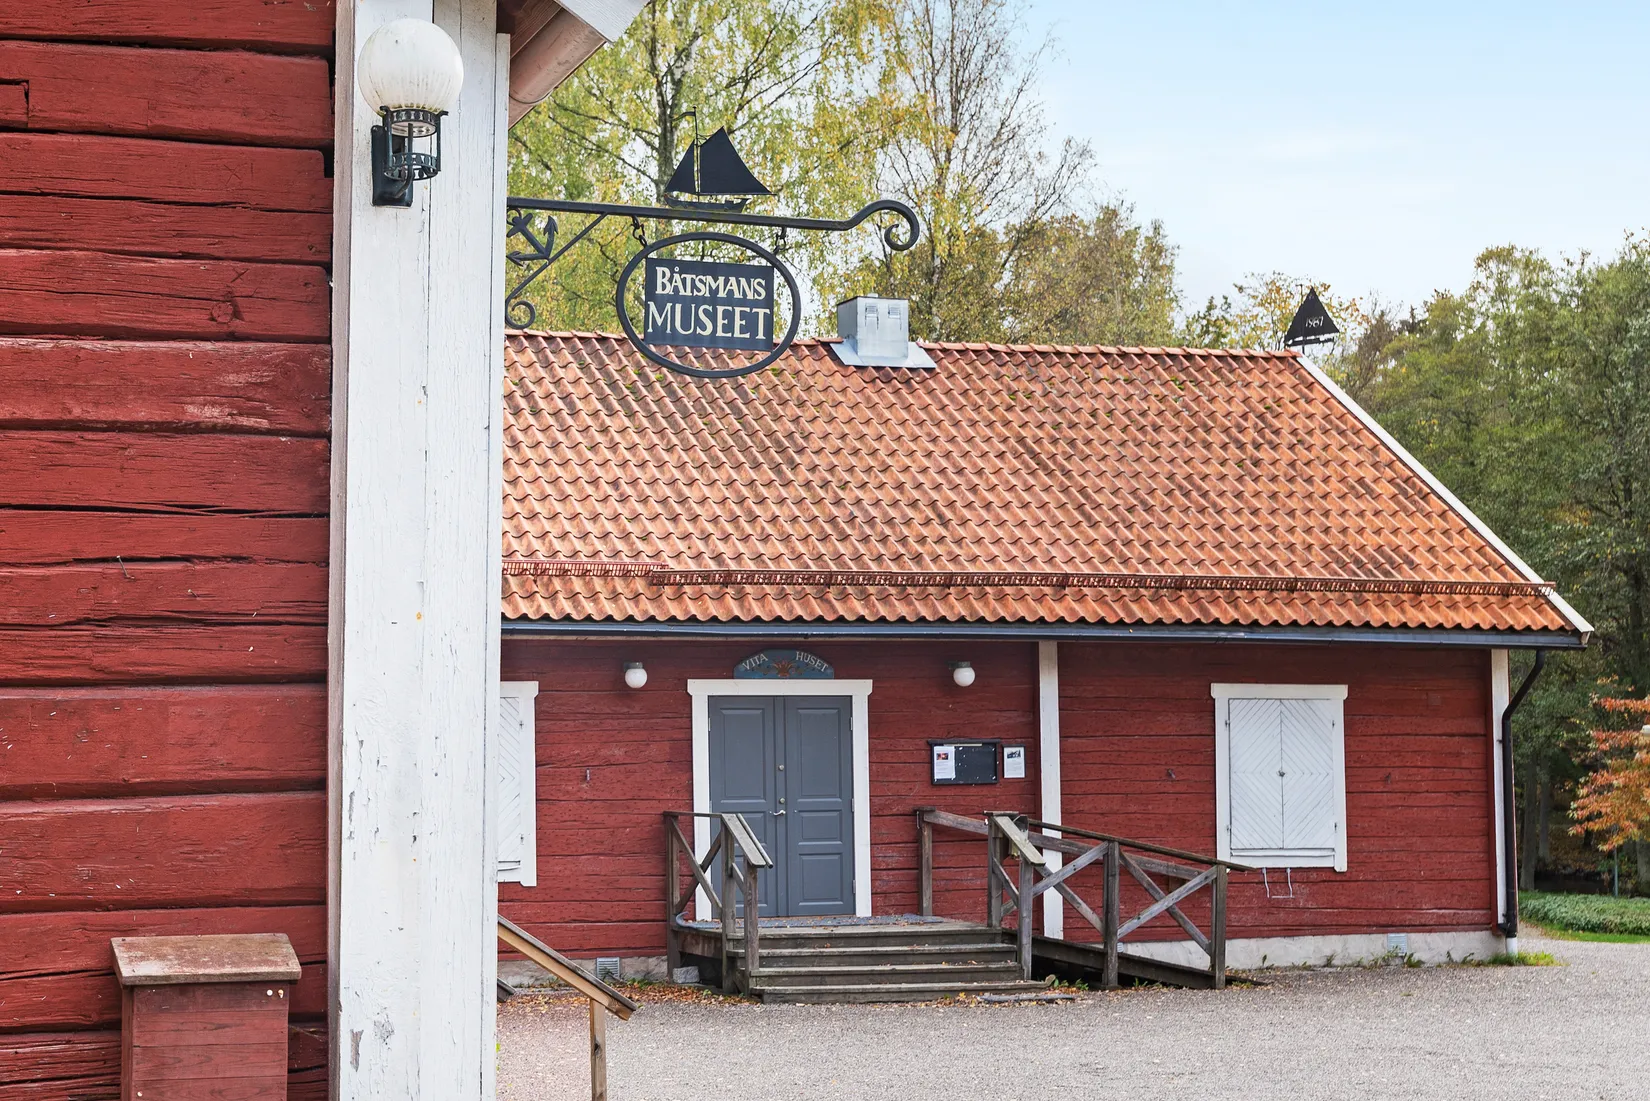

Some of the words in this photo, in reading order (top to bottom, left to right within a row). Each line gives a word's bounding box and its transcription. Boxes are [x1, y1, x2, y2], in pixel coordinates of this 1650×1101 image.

[655, 266, 766, 300] BÅTSMANS
[647, 301, 770, 339] MUSEET
[742, 653, 768, 670] VITA
[795, 651, 829, 672] HUSET
